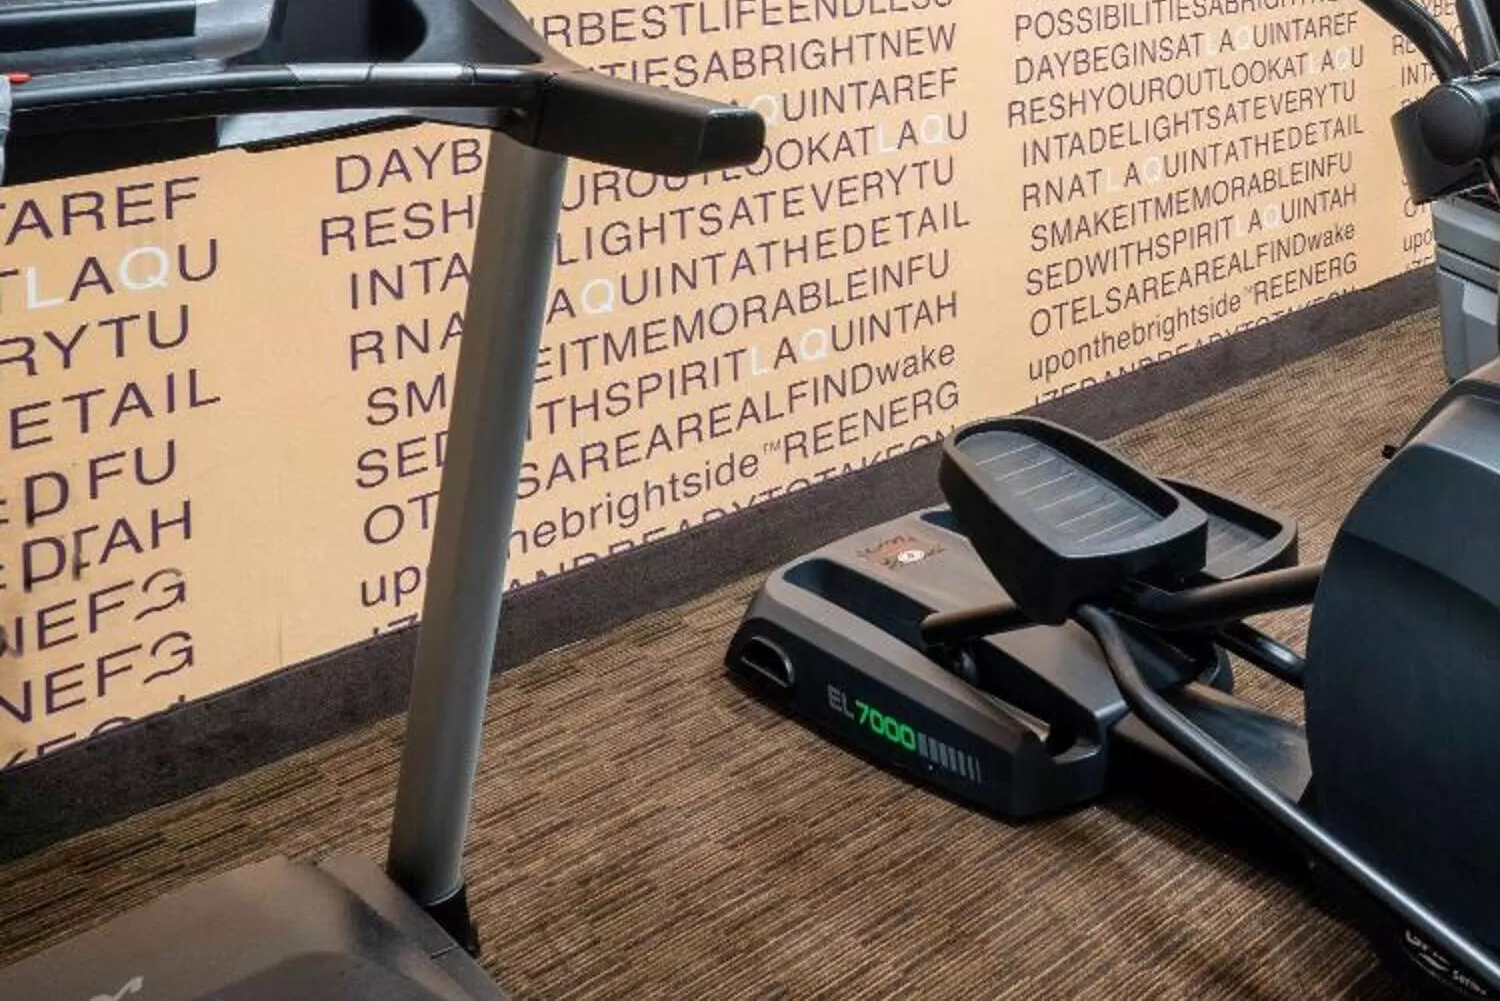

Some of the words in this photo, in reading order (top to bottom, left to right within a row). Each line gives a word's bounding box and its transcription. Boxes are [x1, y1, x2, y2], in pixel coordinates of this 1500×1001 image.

[1023, 79, 1355, 167] INTADELIGHTSATEVERYTU
[0, 176, 200, 246] AREF
[1031, 151, 1351, 252] SMAKEITMEMORABLEINFU
[0, 238, 218, 311] LAQU
[1030, 222, 1355, 337] OTELSAREAREALFINDwake
[9, 368, 220, 450] ETAIL
